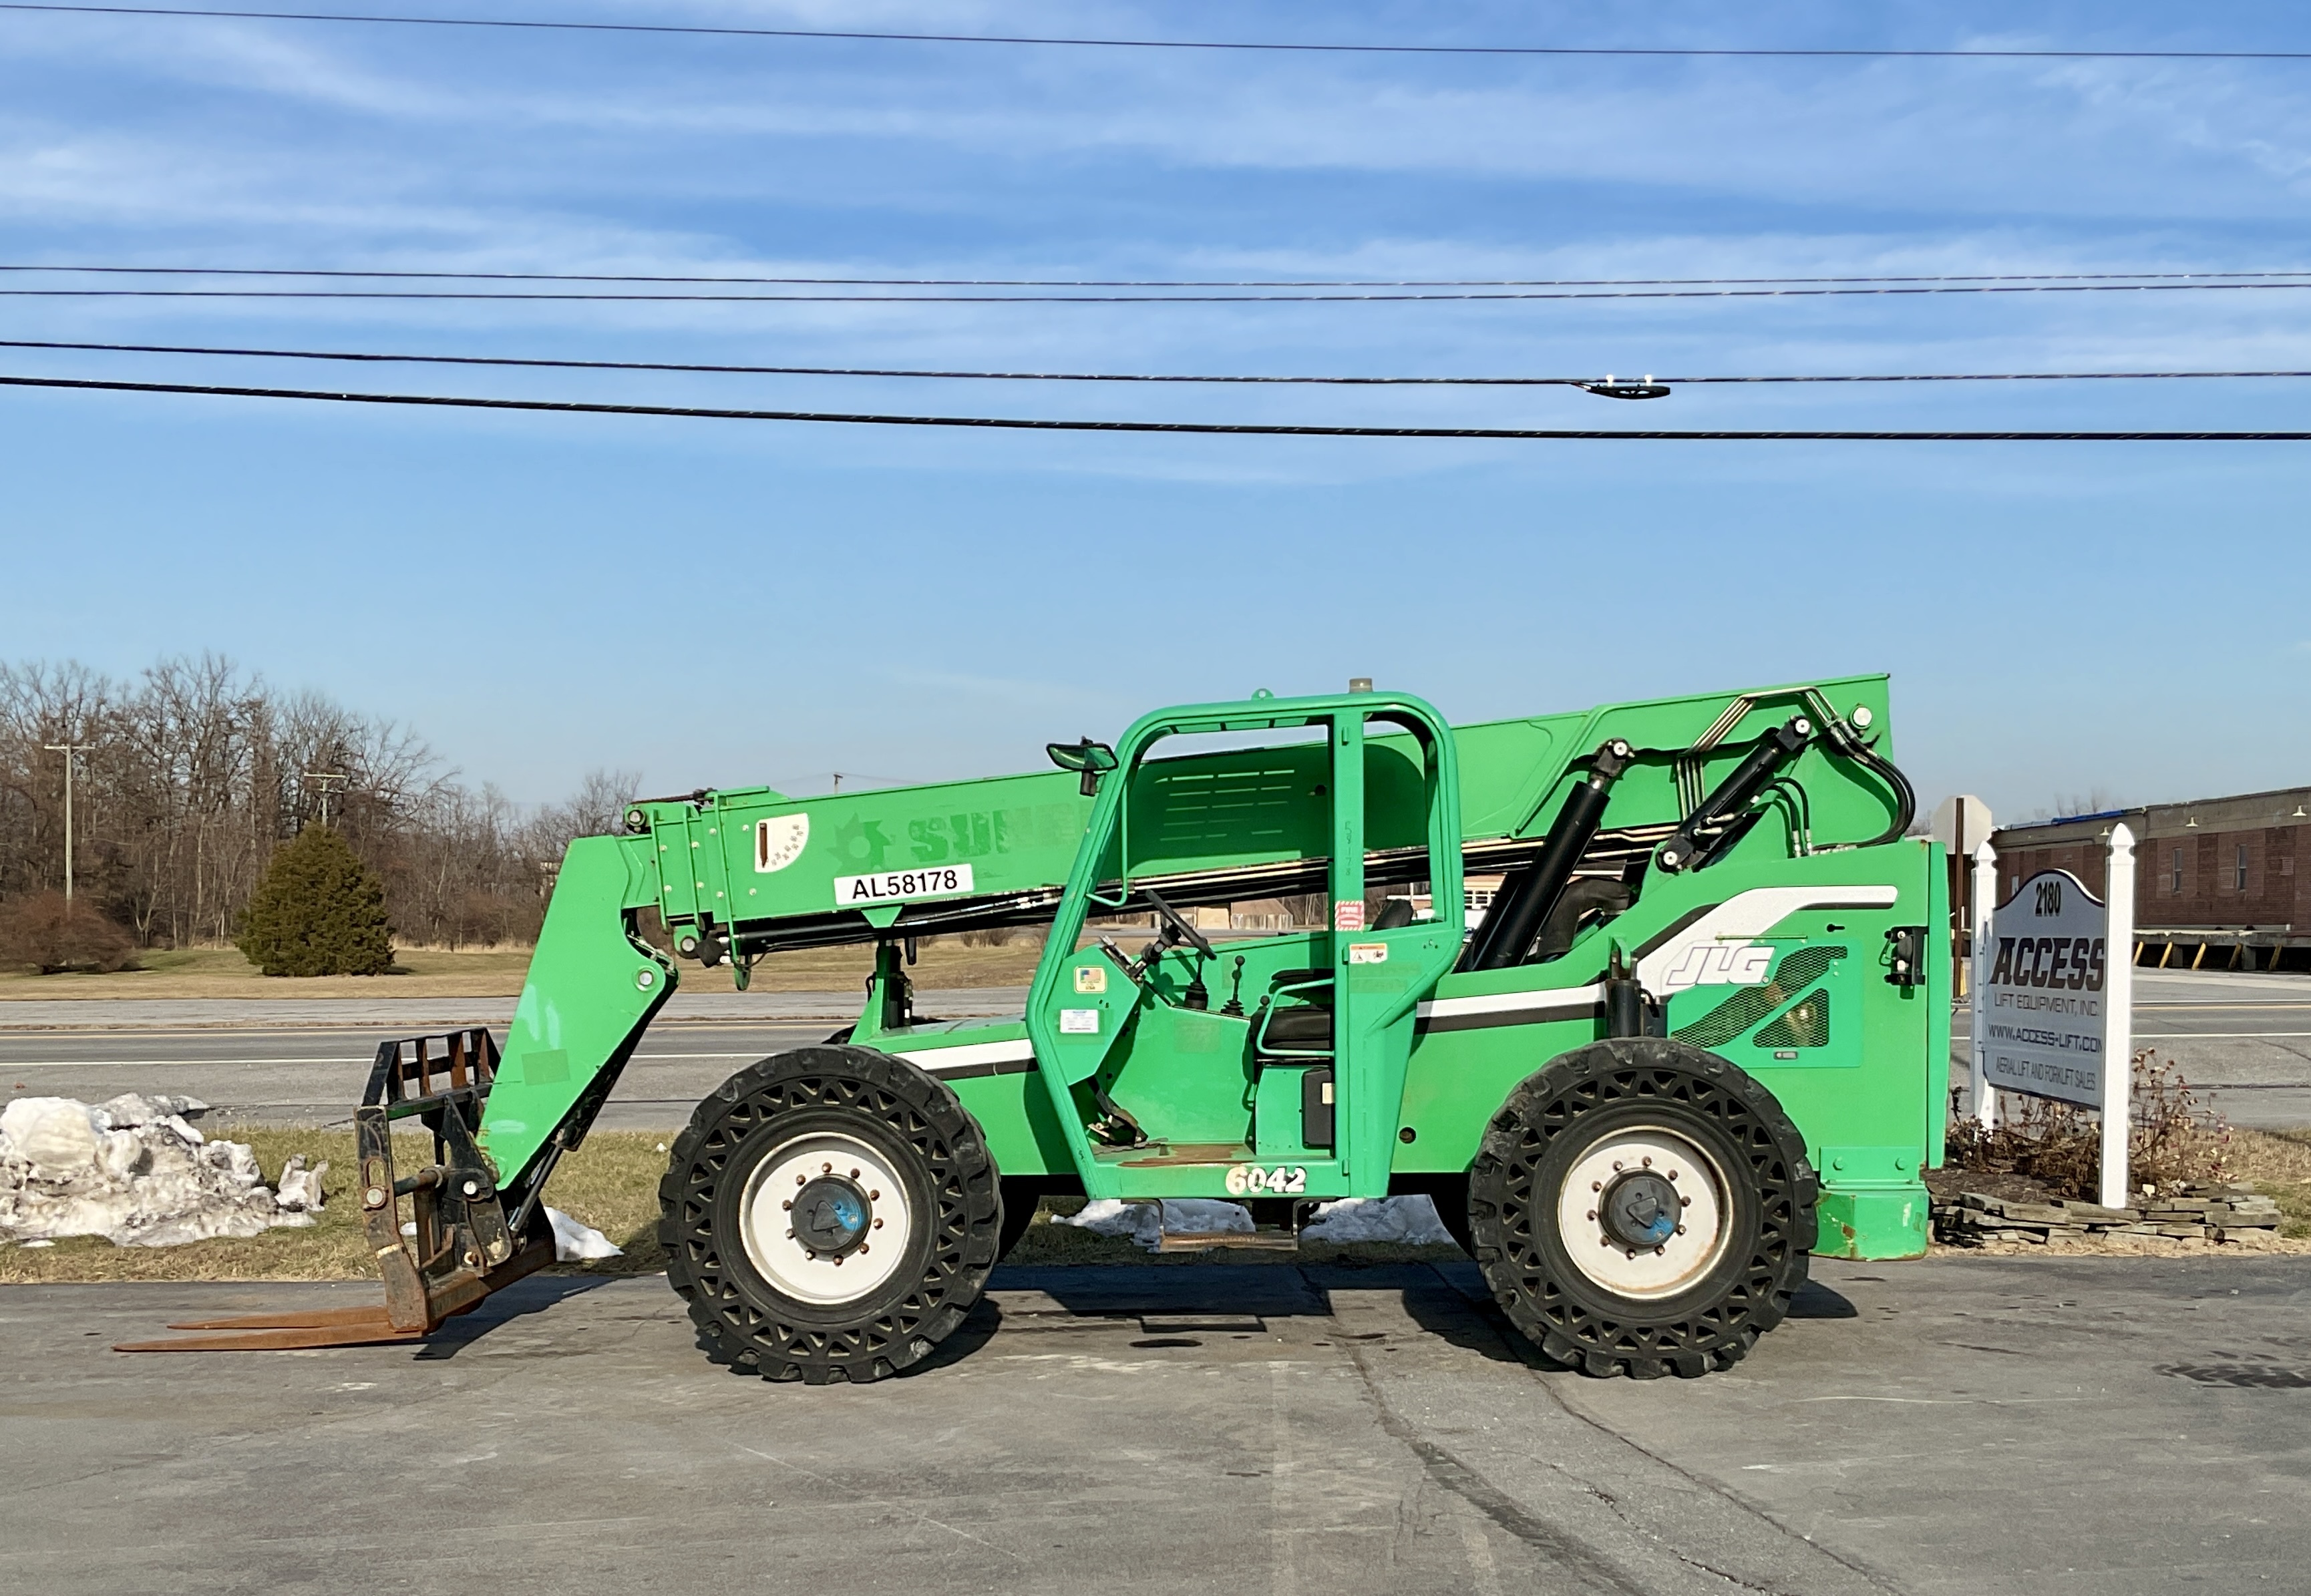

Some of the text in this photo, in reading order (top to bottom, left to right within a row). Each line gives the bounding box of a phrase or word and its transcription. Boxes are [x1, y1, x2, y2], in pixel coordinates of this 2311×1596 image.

[852, 869, 958, 900] AL58178
[2035, 881, 2061, 917] 2180
[1666, 946, 1775, 986] JLG
[1989, 937, 2105, 992] ACCESS
[1994, 992, 2099, 1017] LIFT EQUIPMENT, INC.
[2031, 1062, 2045, 1080] AND
[2045, 1064, 2074, 1086] FORKLIFT
[2075, 1070, 2096, 1090] SALES
[1226, 1166, 1306, 1195] 6042
